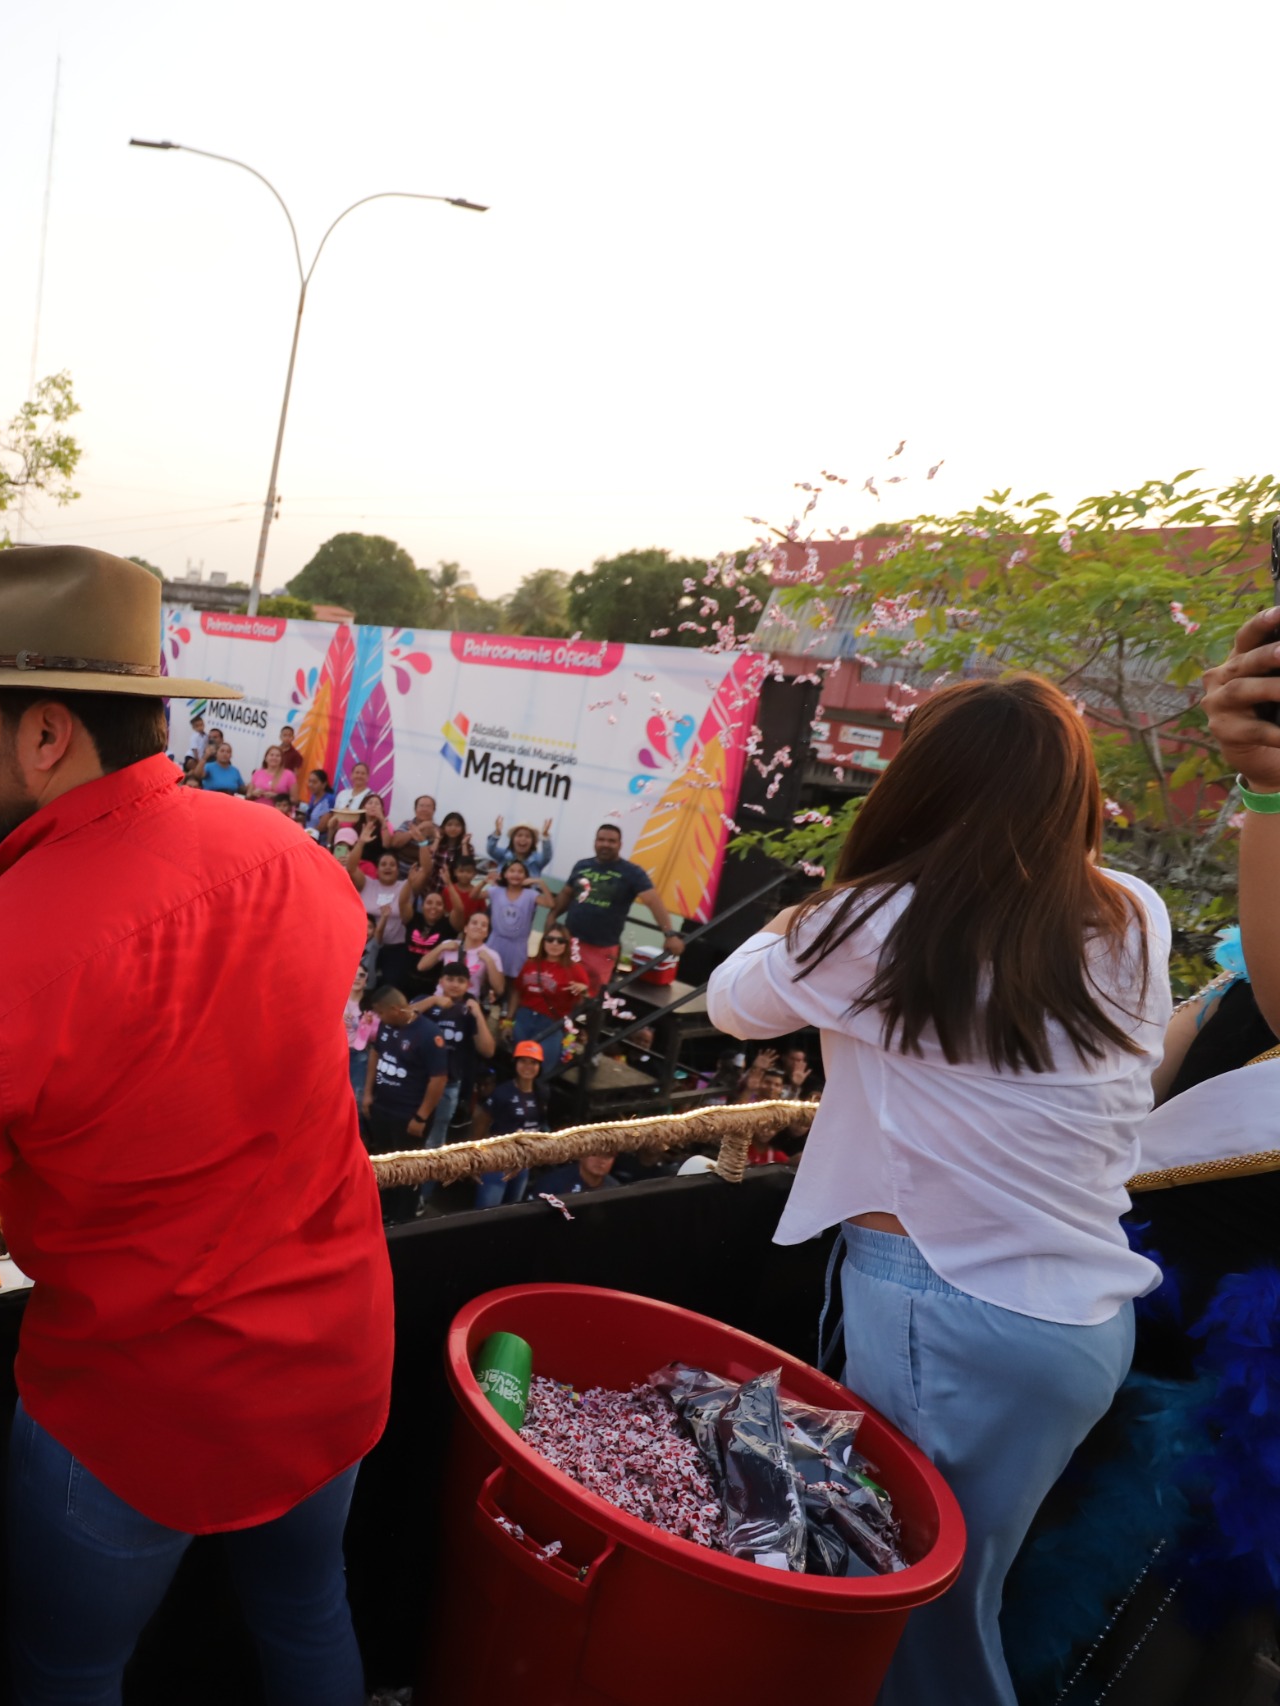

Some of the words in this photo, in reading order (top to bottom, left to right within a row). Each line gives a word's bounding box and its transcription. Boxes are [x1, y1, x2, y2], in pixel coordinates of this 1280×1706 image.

[463, 638, 551, 664] Patrocinante
[554, 647, 604, 669] Oficial
[208, 700, 268, 729] MONAGAS
[472, 723, 509, 739] Alcaldía
[470, 736, 516, 754] Bolivariana
[517, 745, 531, 757] del
[533, 748, 577, 765] Municipio
[463, 749, 572, 801] Maturín
